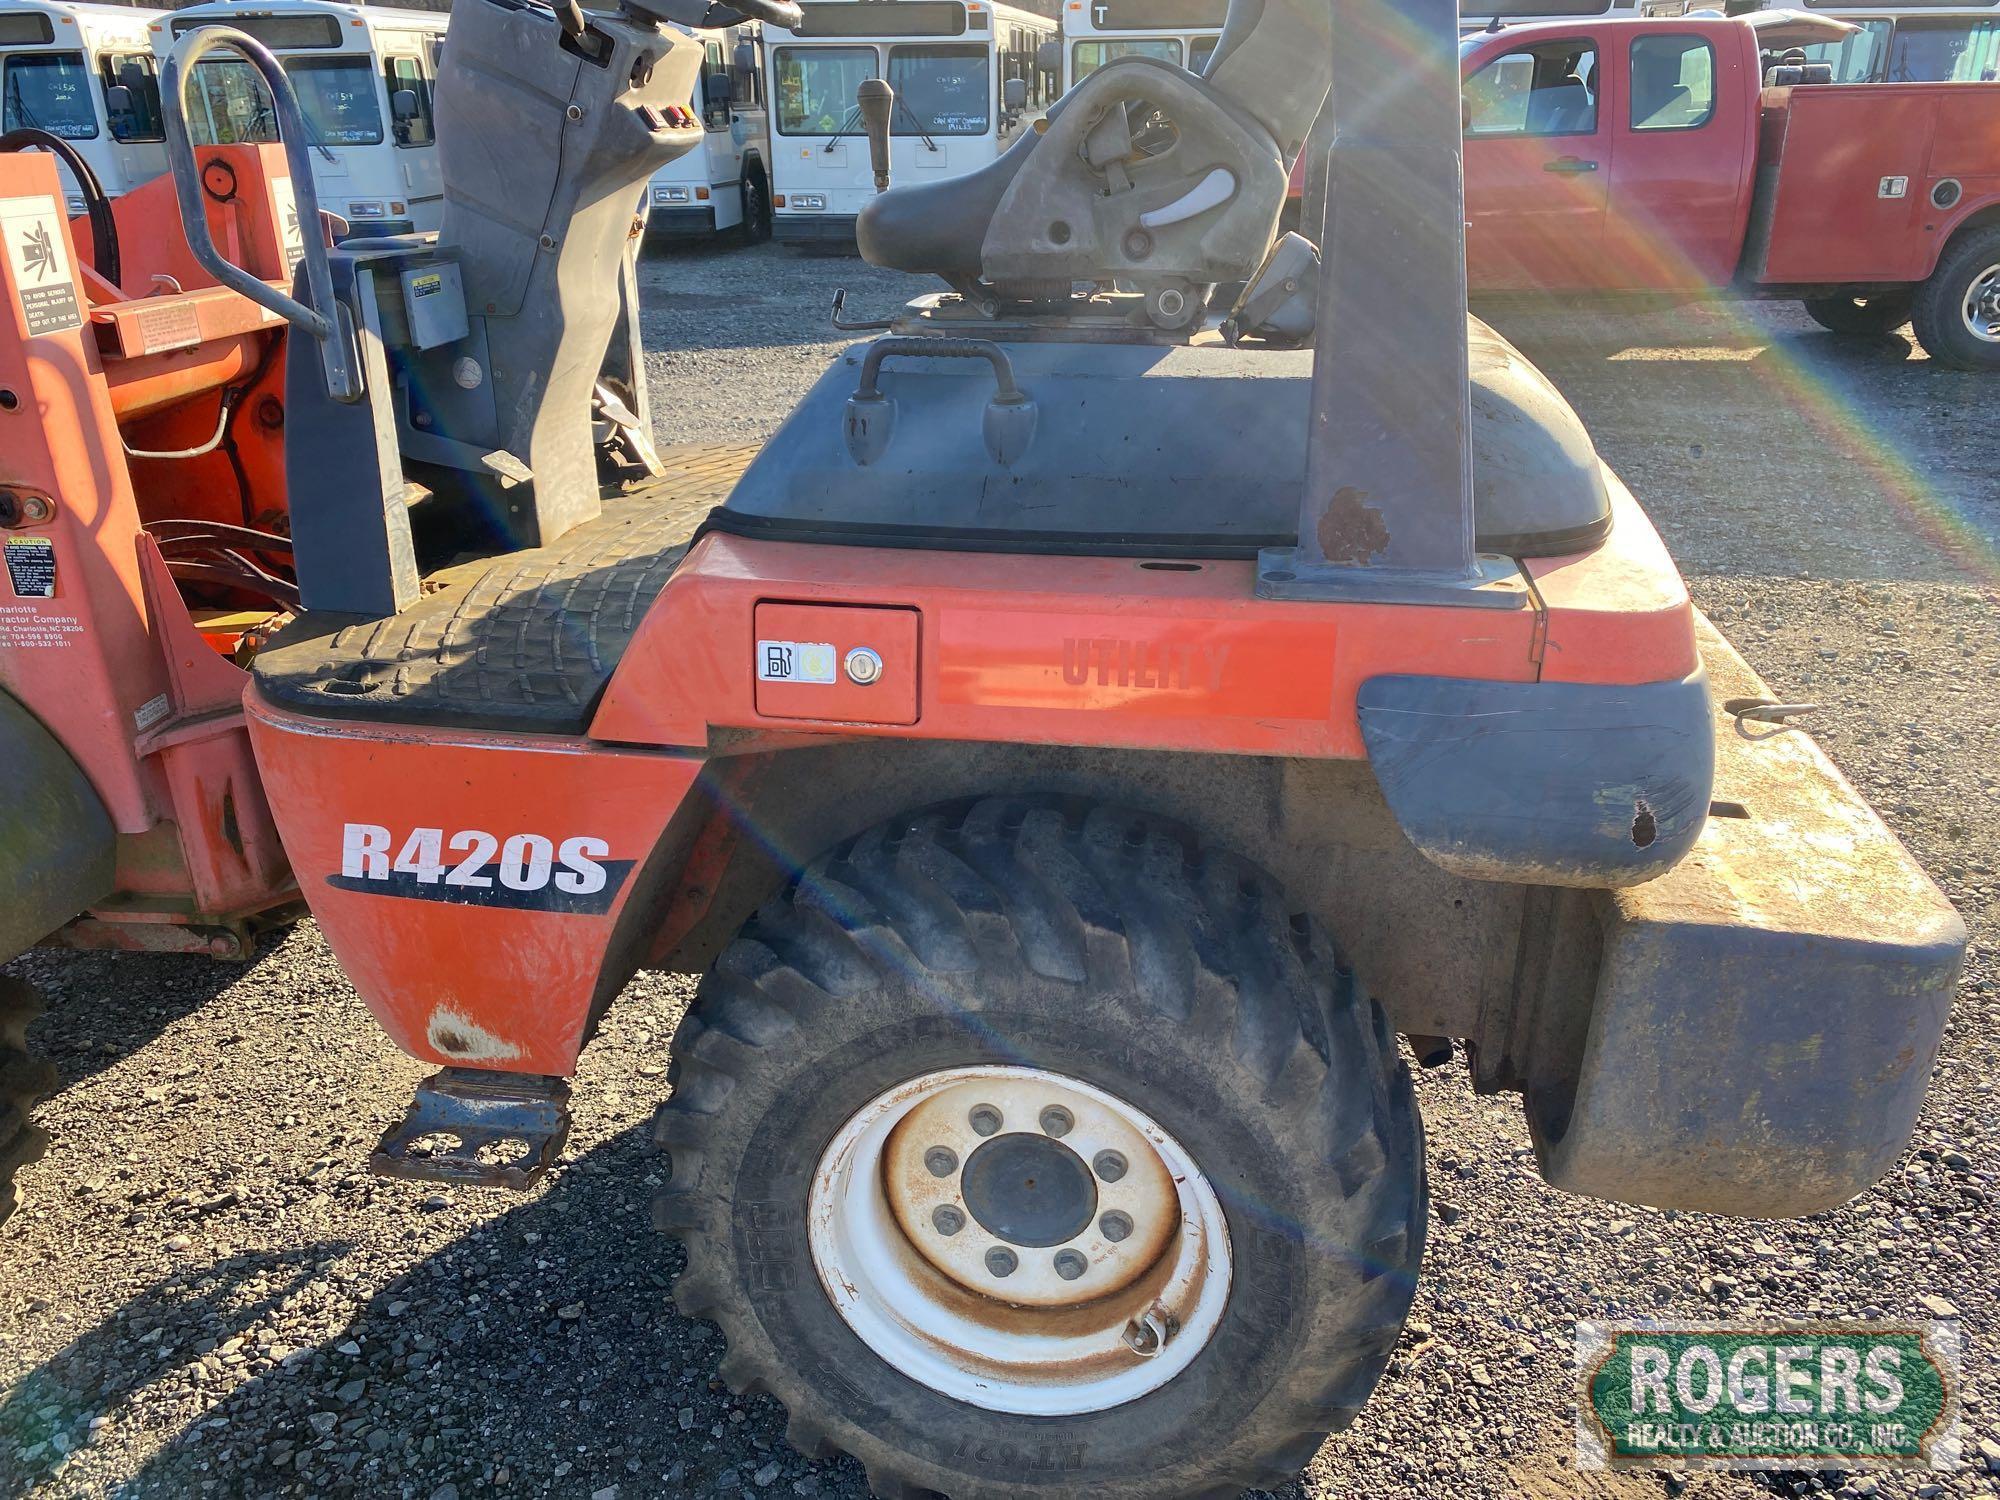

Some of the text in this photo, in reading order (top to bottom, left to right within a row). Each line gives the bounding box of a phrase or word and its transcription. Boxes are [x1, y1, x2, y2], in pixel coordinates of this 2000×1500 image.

[1095, 6, 1108, 24] T
[33, 615, 78, 625] Company
[1062, 638, 1232, 691] UTILITY
[341, 823, 610, 894] R420S
